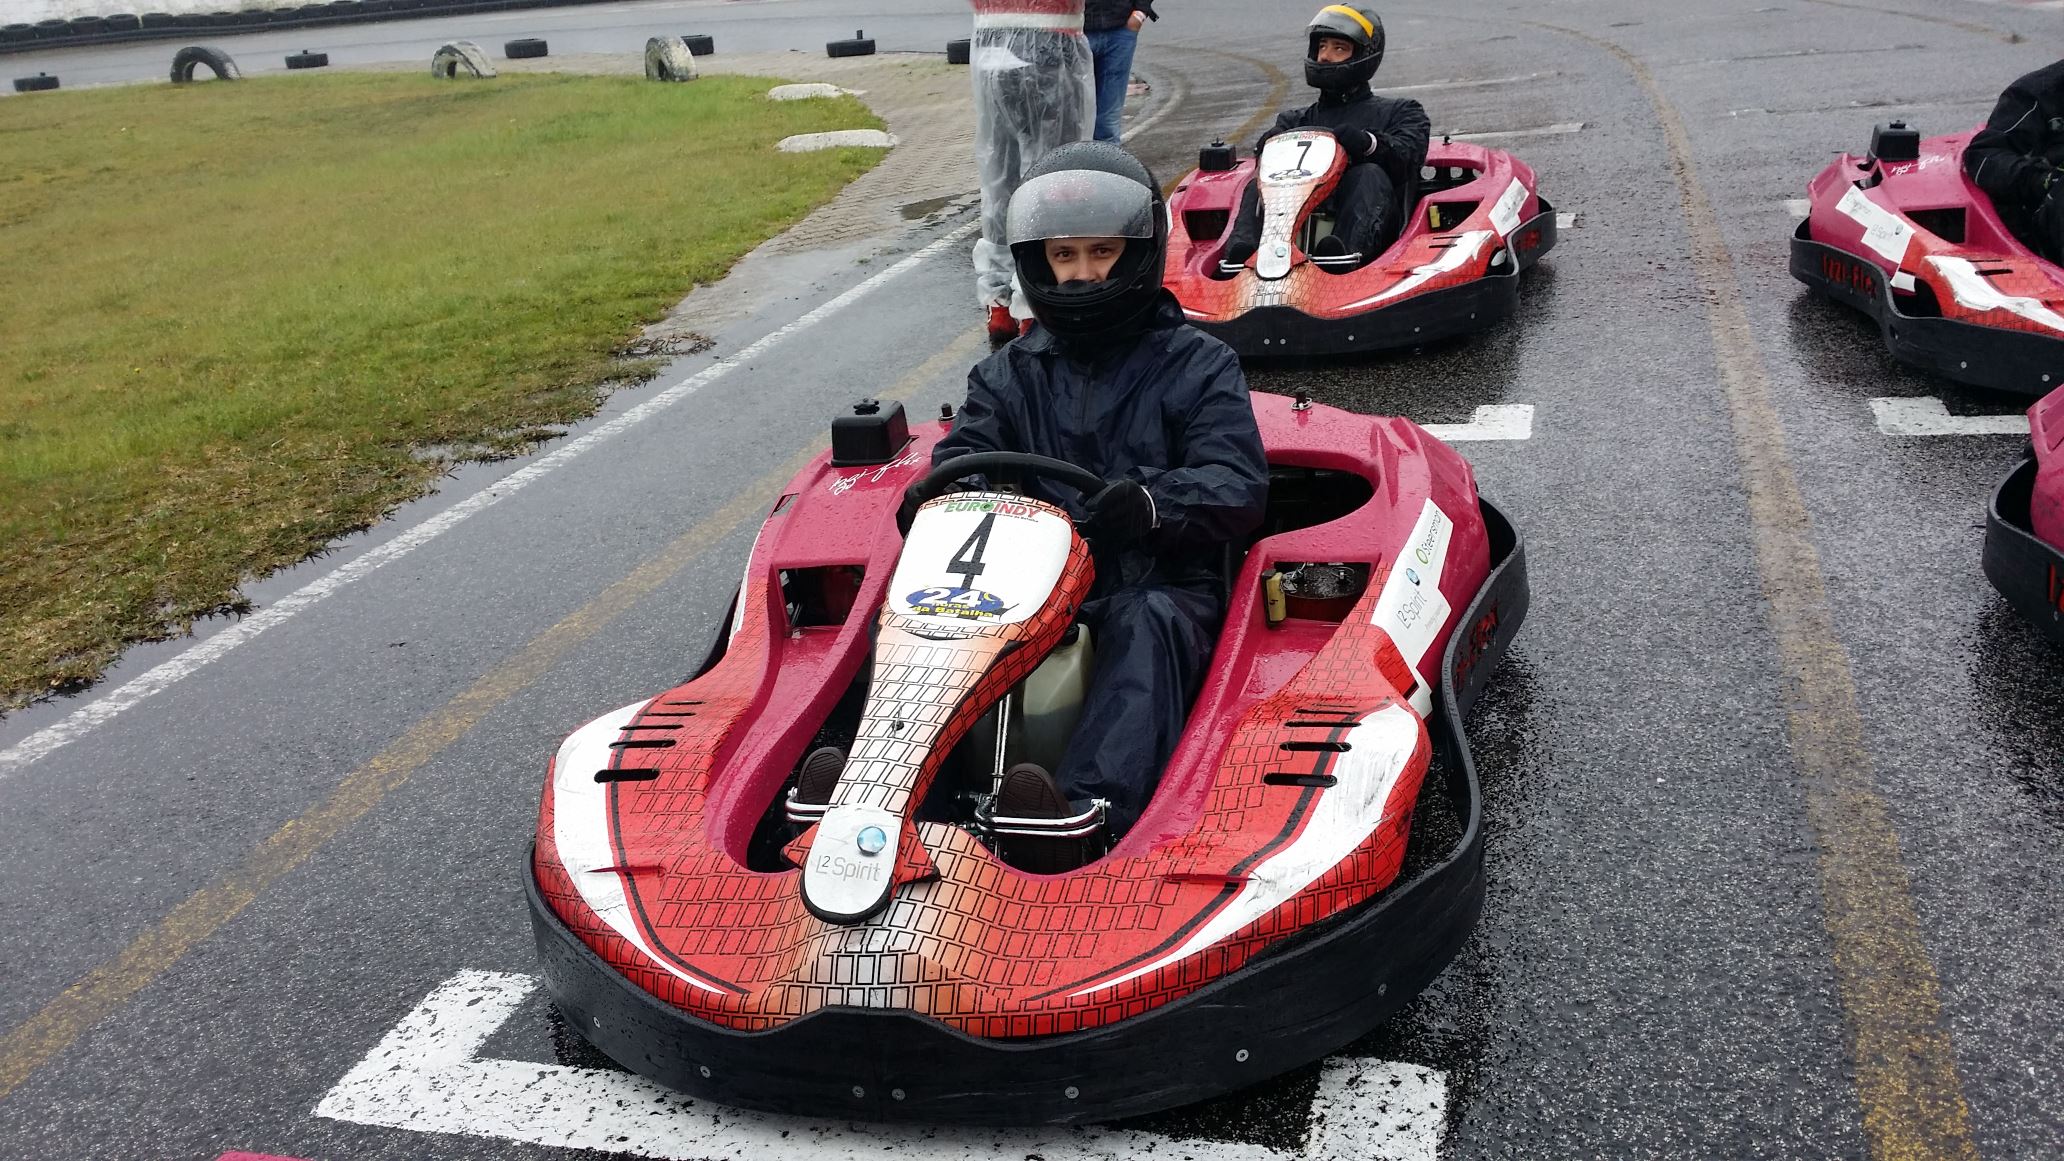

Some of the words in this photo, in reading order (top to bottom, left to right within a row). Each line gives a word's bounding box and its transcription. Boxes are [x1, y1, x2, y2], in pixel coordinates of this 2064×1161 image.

[1297, 141, 1312, 170] 7
[944, 502, 1041, 518] EUROINDY
[945, 512, 997, 590] 4
[918, 587, 982, 608] 24
[911, 605, 930, 613] da
[934, 606, 994, 618] Batalha
[832, 856, 881, 882] Spirit
